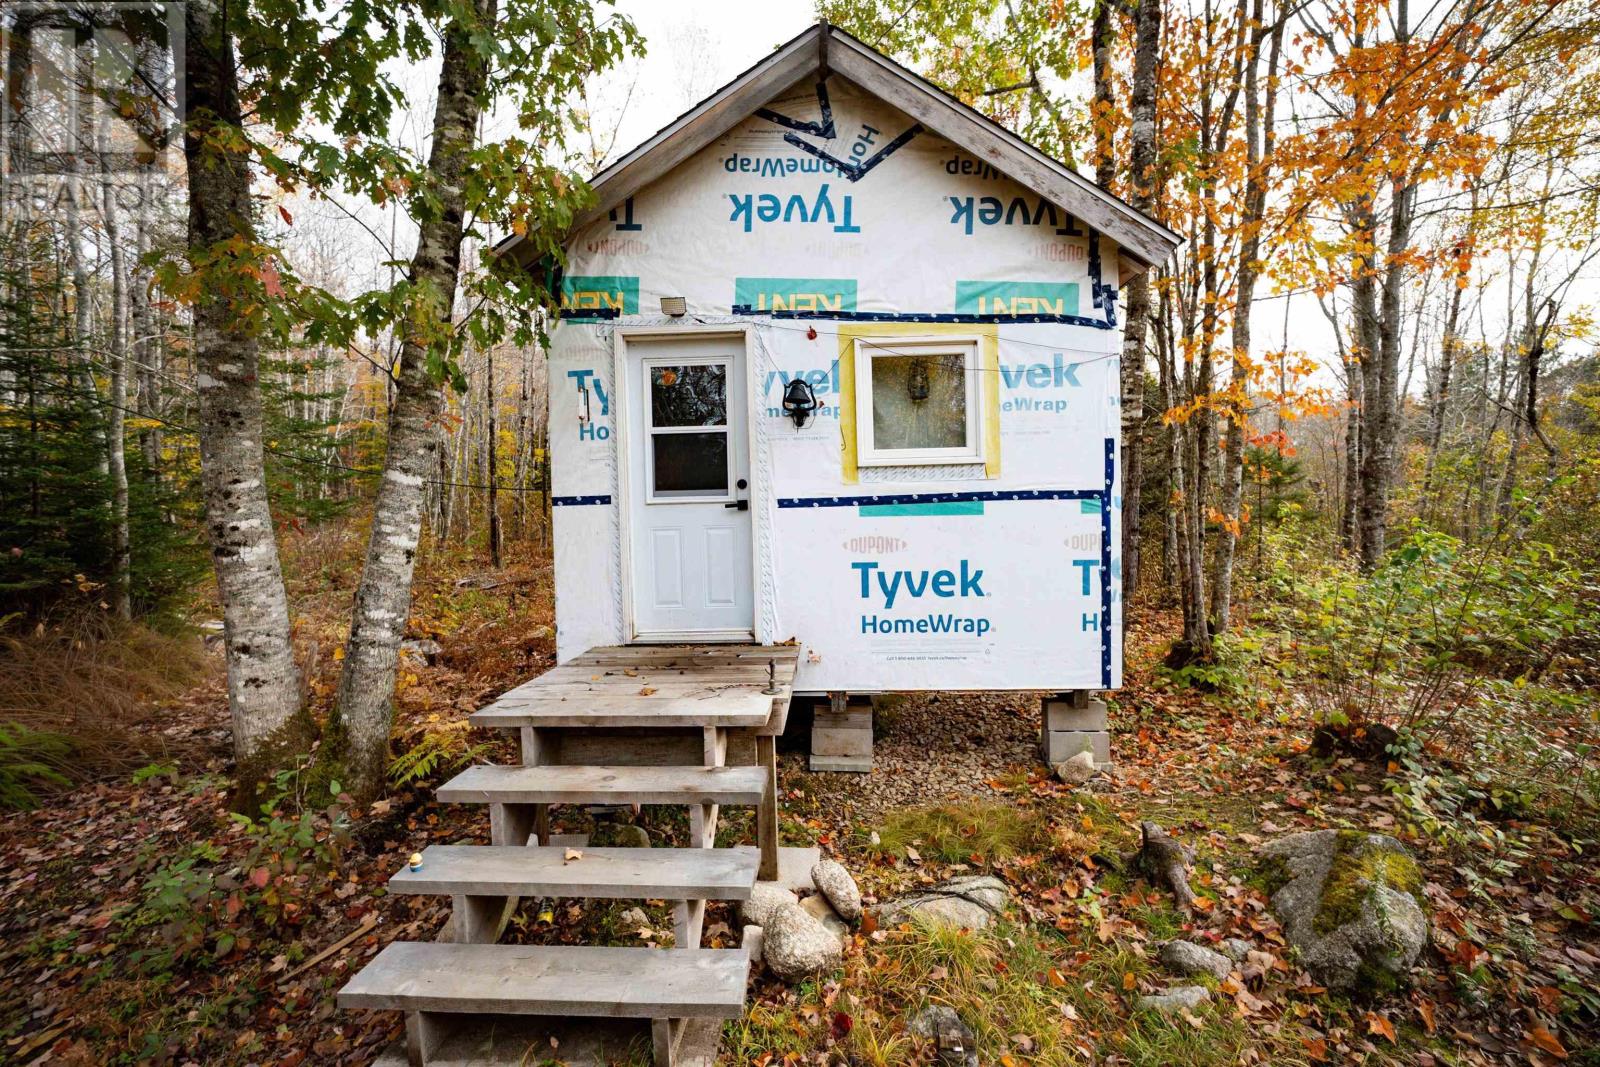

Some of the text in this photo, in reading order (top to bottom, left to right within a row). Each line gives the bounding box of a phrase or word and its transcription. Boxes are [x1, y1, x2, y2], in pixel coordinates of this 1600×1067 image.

[724, 153, 842, 178] omeWrap
[728, 184, 861, 233] Tyvek
[850, 535, 900, 555] DUPONT
[851, 559, 985, 609] Tyvek
[861, 613, 990, 637] HomeWrap
